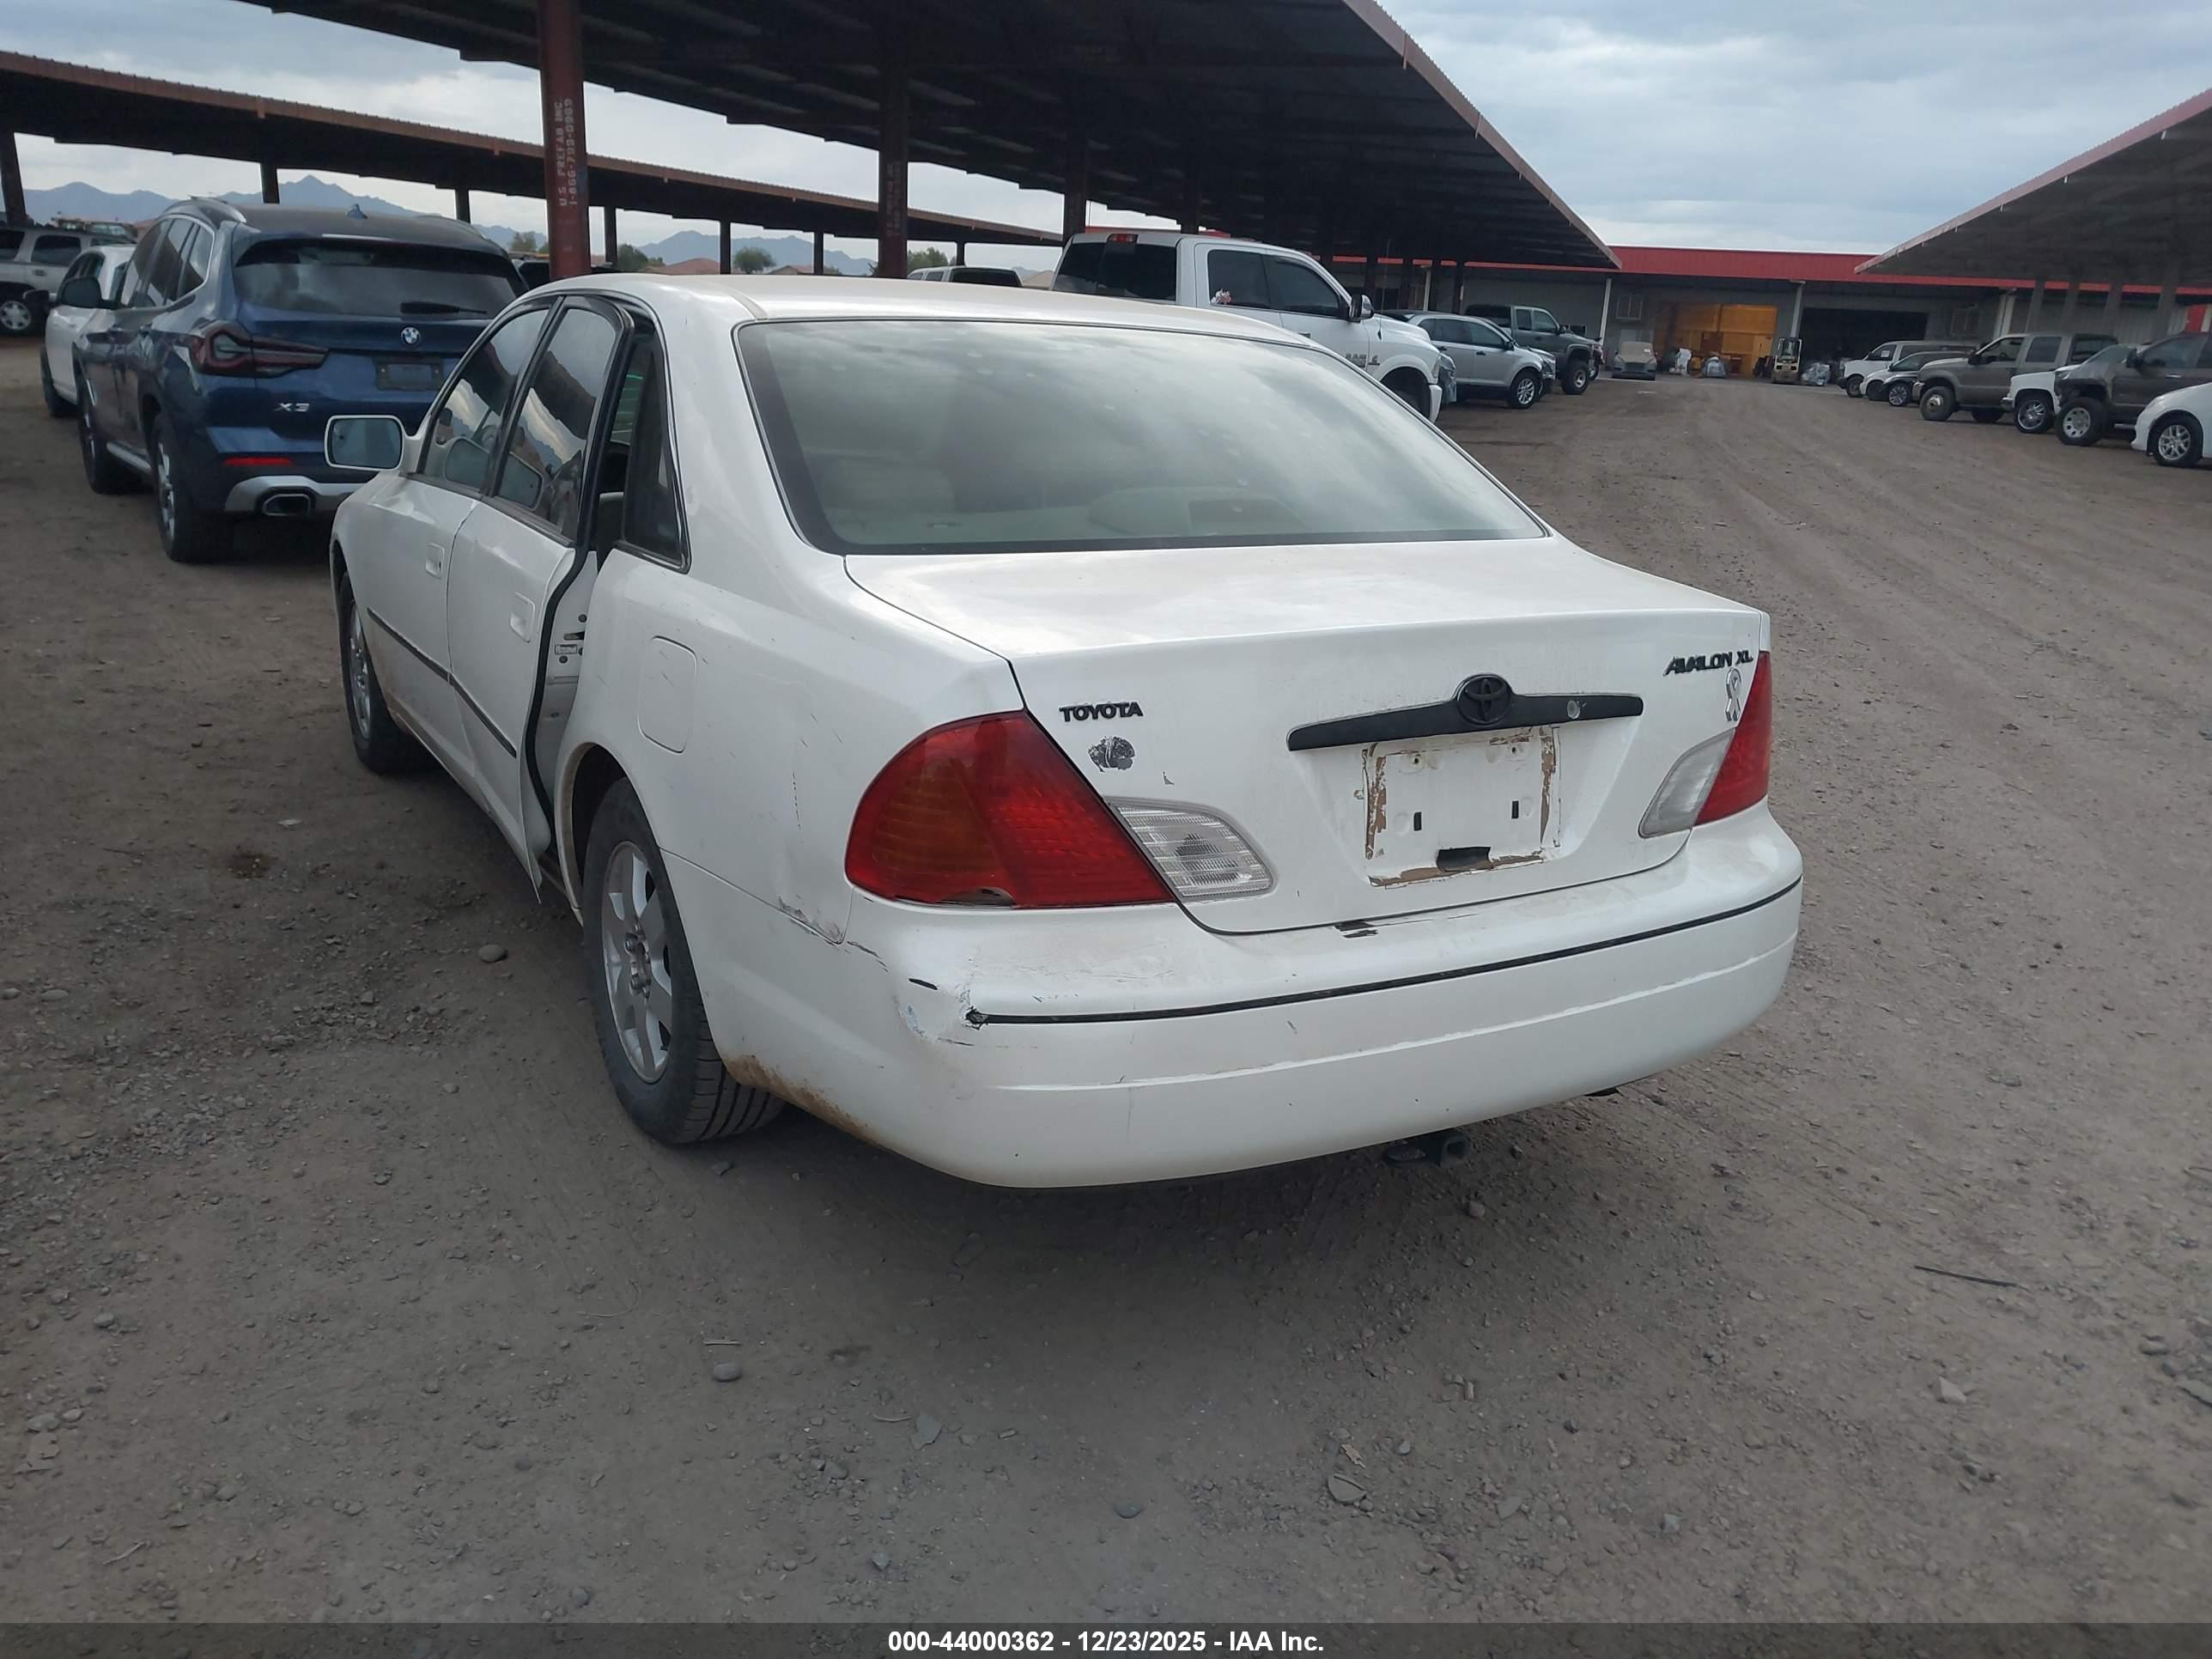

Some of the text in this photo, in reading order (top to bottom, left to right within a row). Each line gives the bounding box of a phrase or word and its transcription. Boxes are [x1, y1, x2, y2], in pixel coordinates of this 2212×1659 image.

[556, 128, 566, 176] PREFAB
[274, 403, 310, 412] X3
[1662, 650, 1753, 677] AVALON XL
[1059, 702, 1144, 722] TOYOTA
